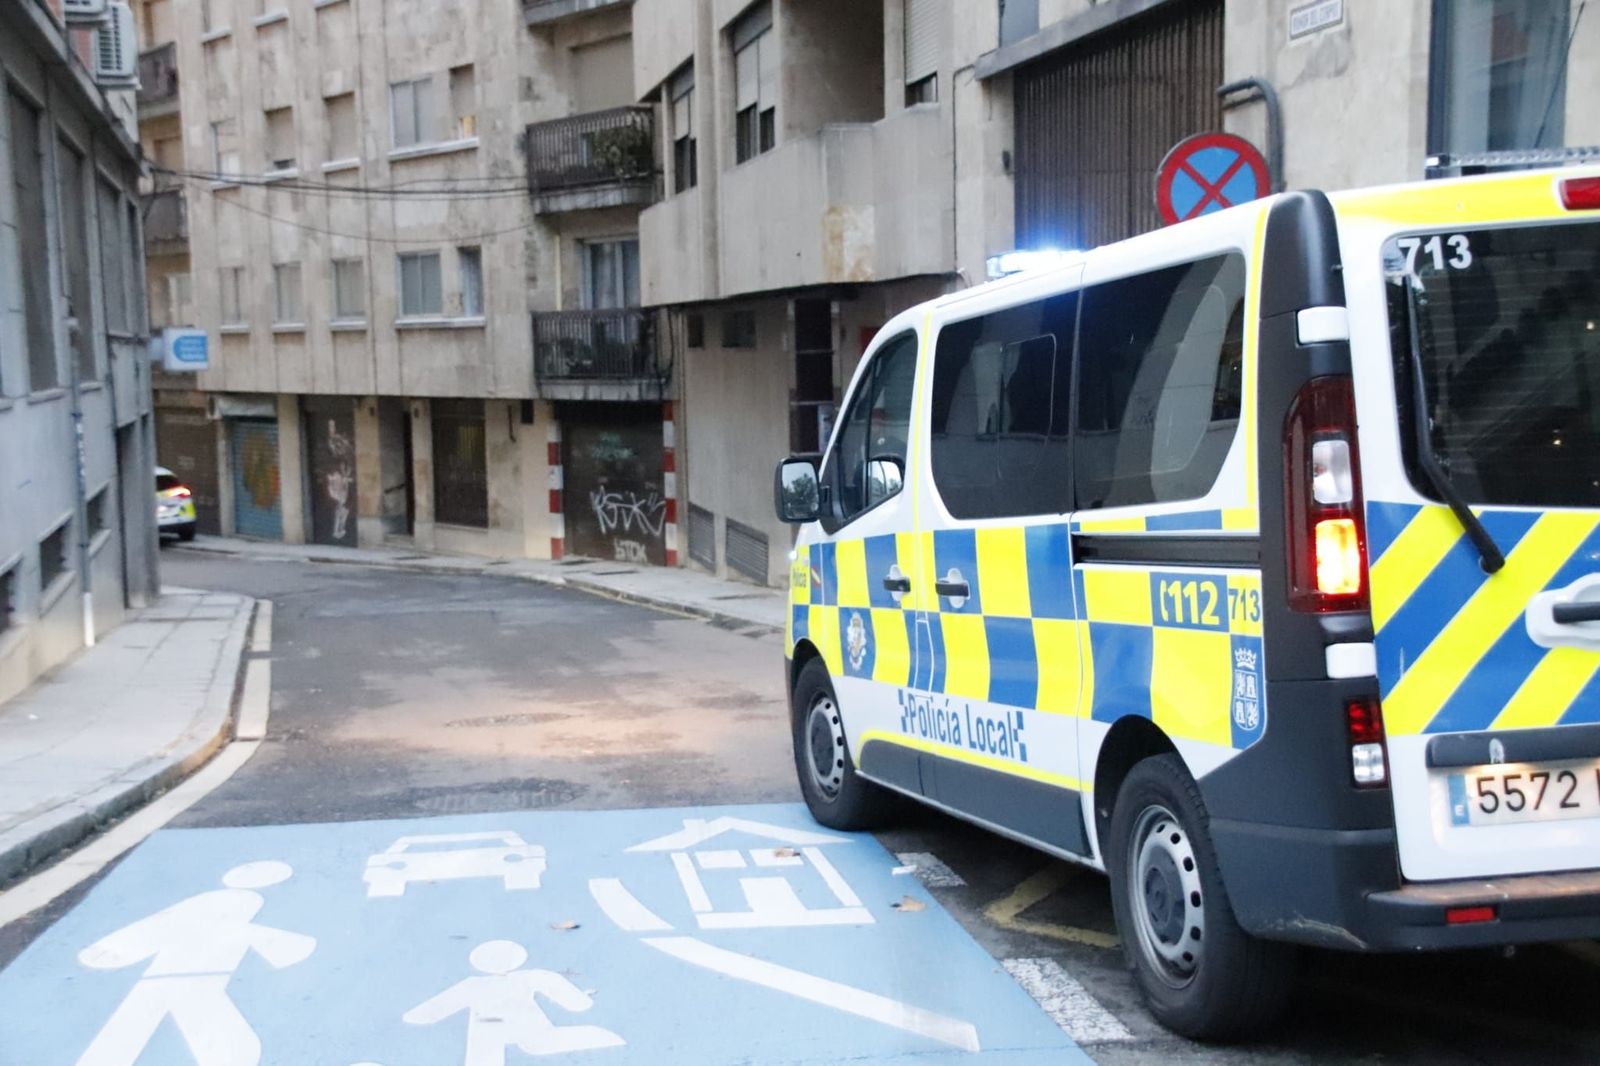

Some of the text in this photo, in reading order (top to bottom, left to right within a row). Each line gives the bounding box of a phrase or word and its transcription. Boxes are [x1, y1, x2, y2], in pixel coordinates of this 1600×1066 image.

[1398, 234, 1473, 276] 713
[1167, 579, 1220, 626] 112
[1228, 588, 1261, 622] 713
[907, 692, 1015, 759] Policía Local
[1476, 769, 1581, 814] 5572
